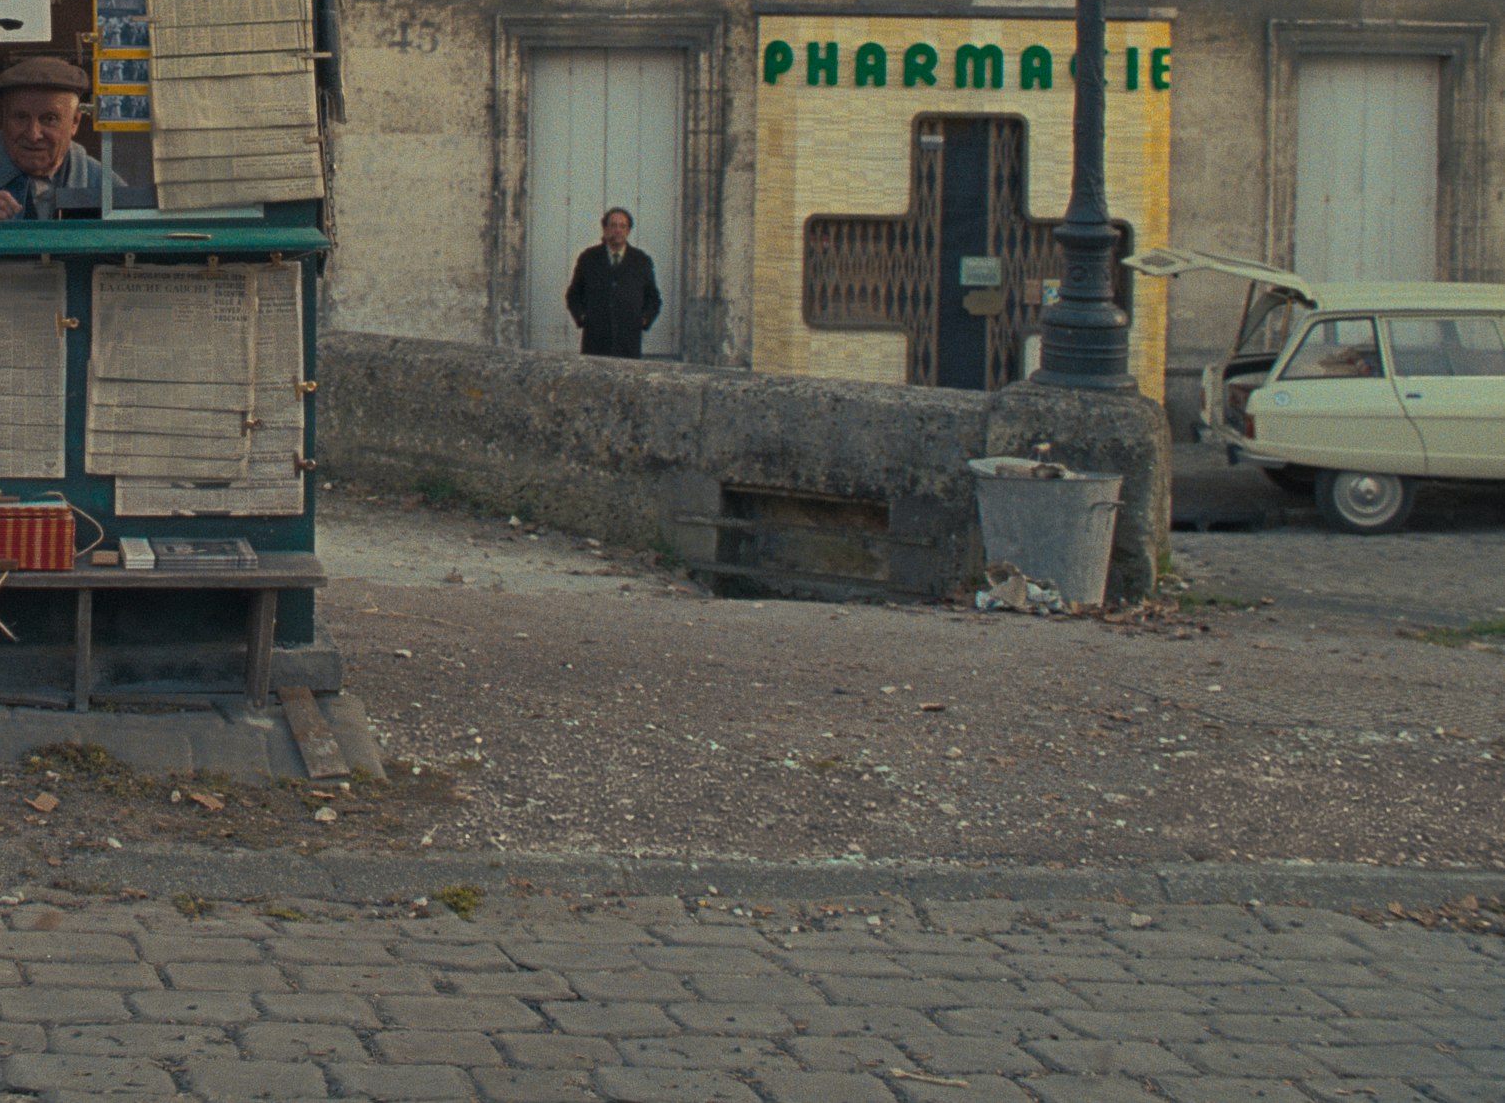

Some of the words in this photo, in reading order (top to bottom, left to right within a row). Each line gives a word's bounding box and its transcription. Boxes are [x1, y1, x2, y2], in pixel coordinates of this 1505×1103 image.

[764, 40, 1172, 91] PHARMAIE
[116, 283, 160, 294] GAUCHE
[164, 284, 208, 294] GAUCHE
